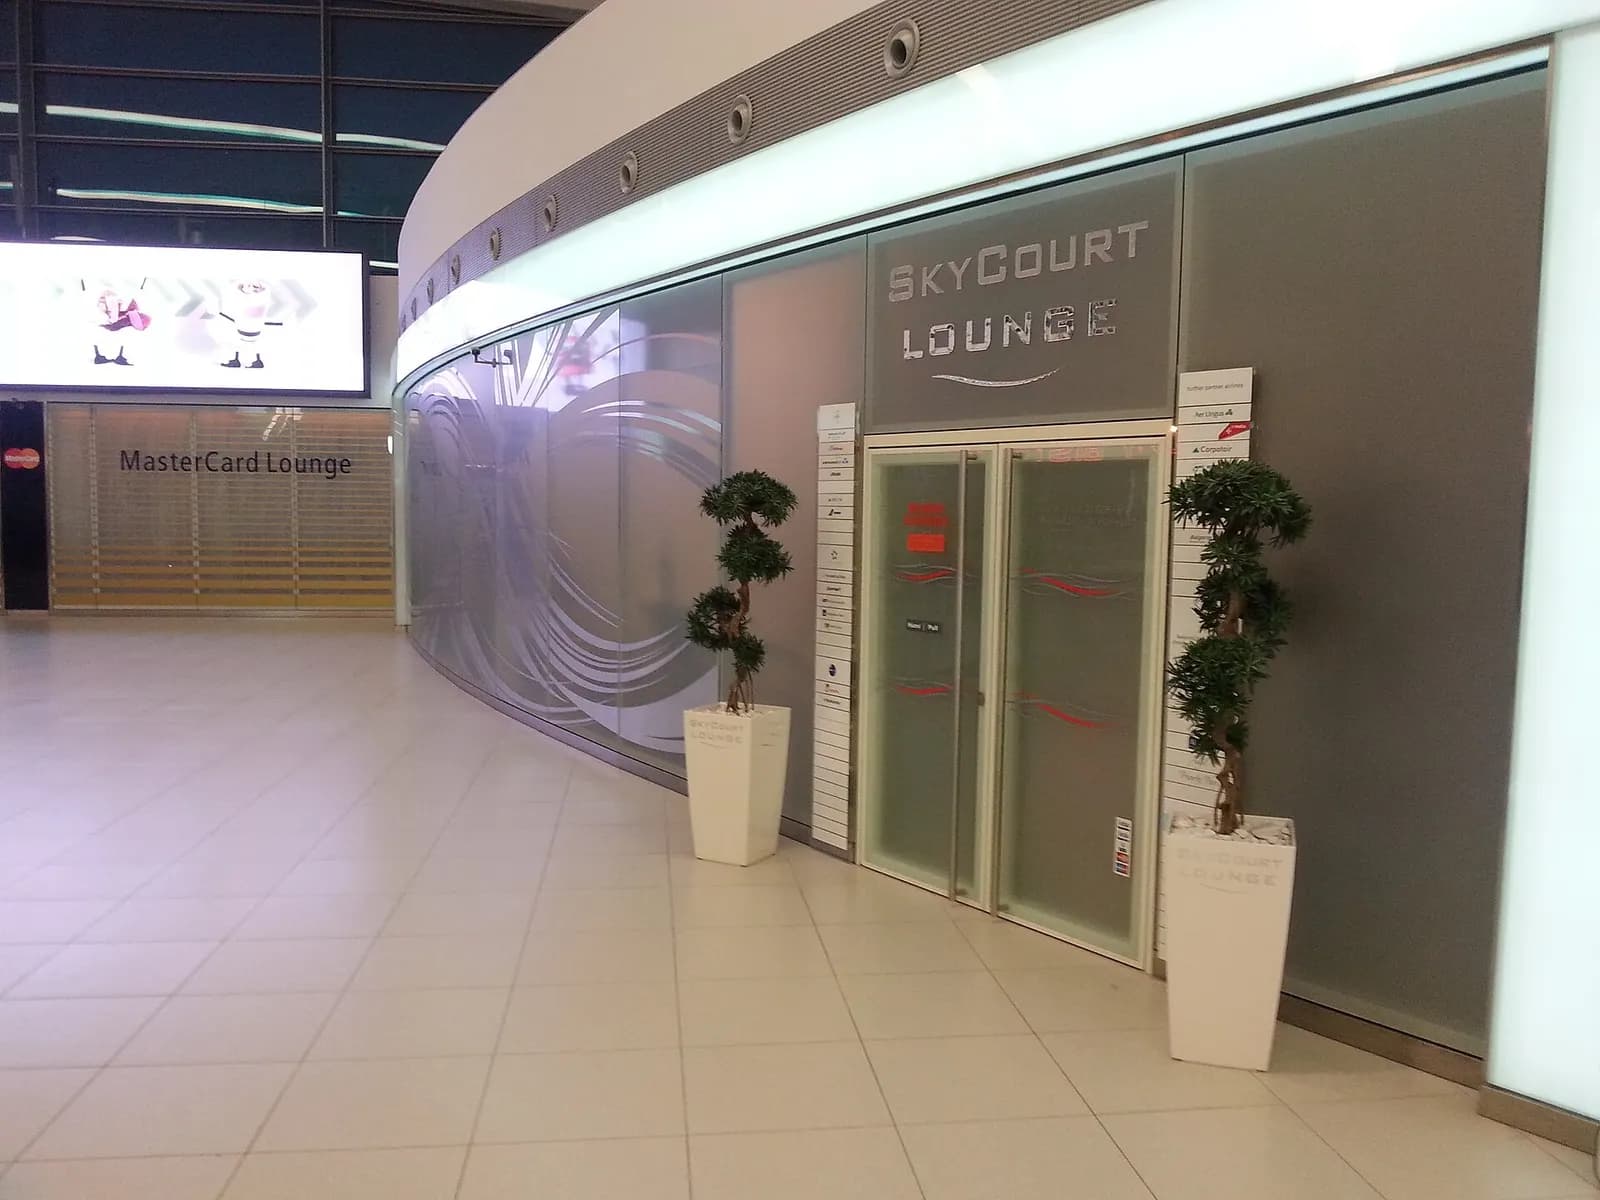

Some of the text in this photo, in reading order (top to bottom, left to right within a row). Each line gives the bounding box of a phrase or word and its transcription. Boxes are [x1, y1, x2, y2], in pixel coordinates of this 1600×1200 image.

[902, 298, 1118, 360] LOUNGE
[120, 450, 352, 479] MasterCard Lounge
